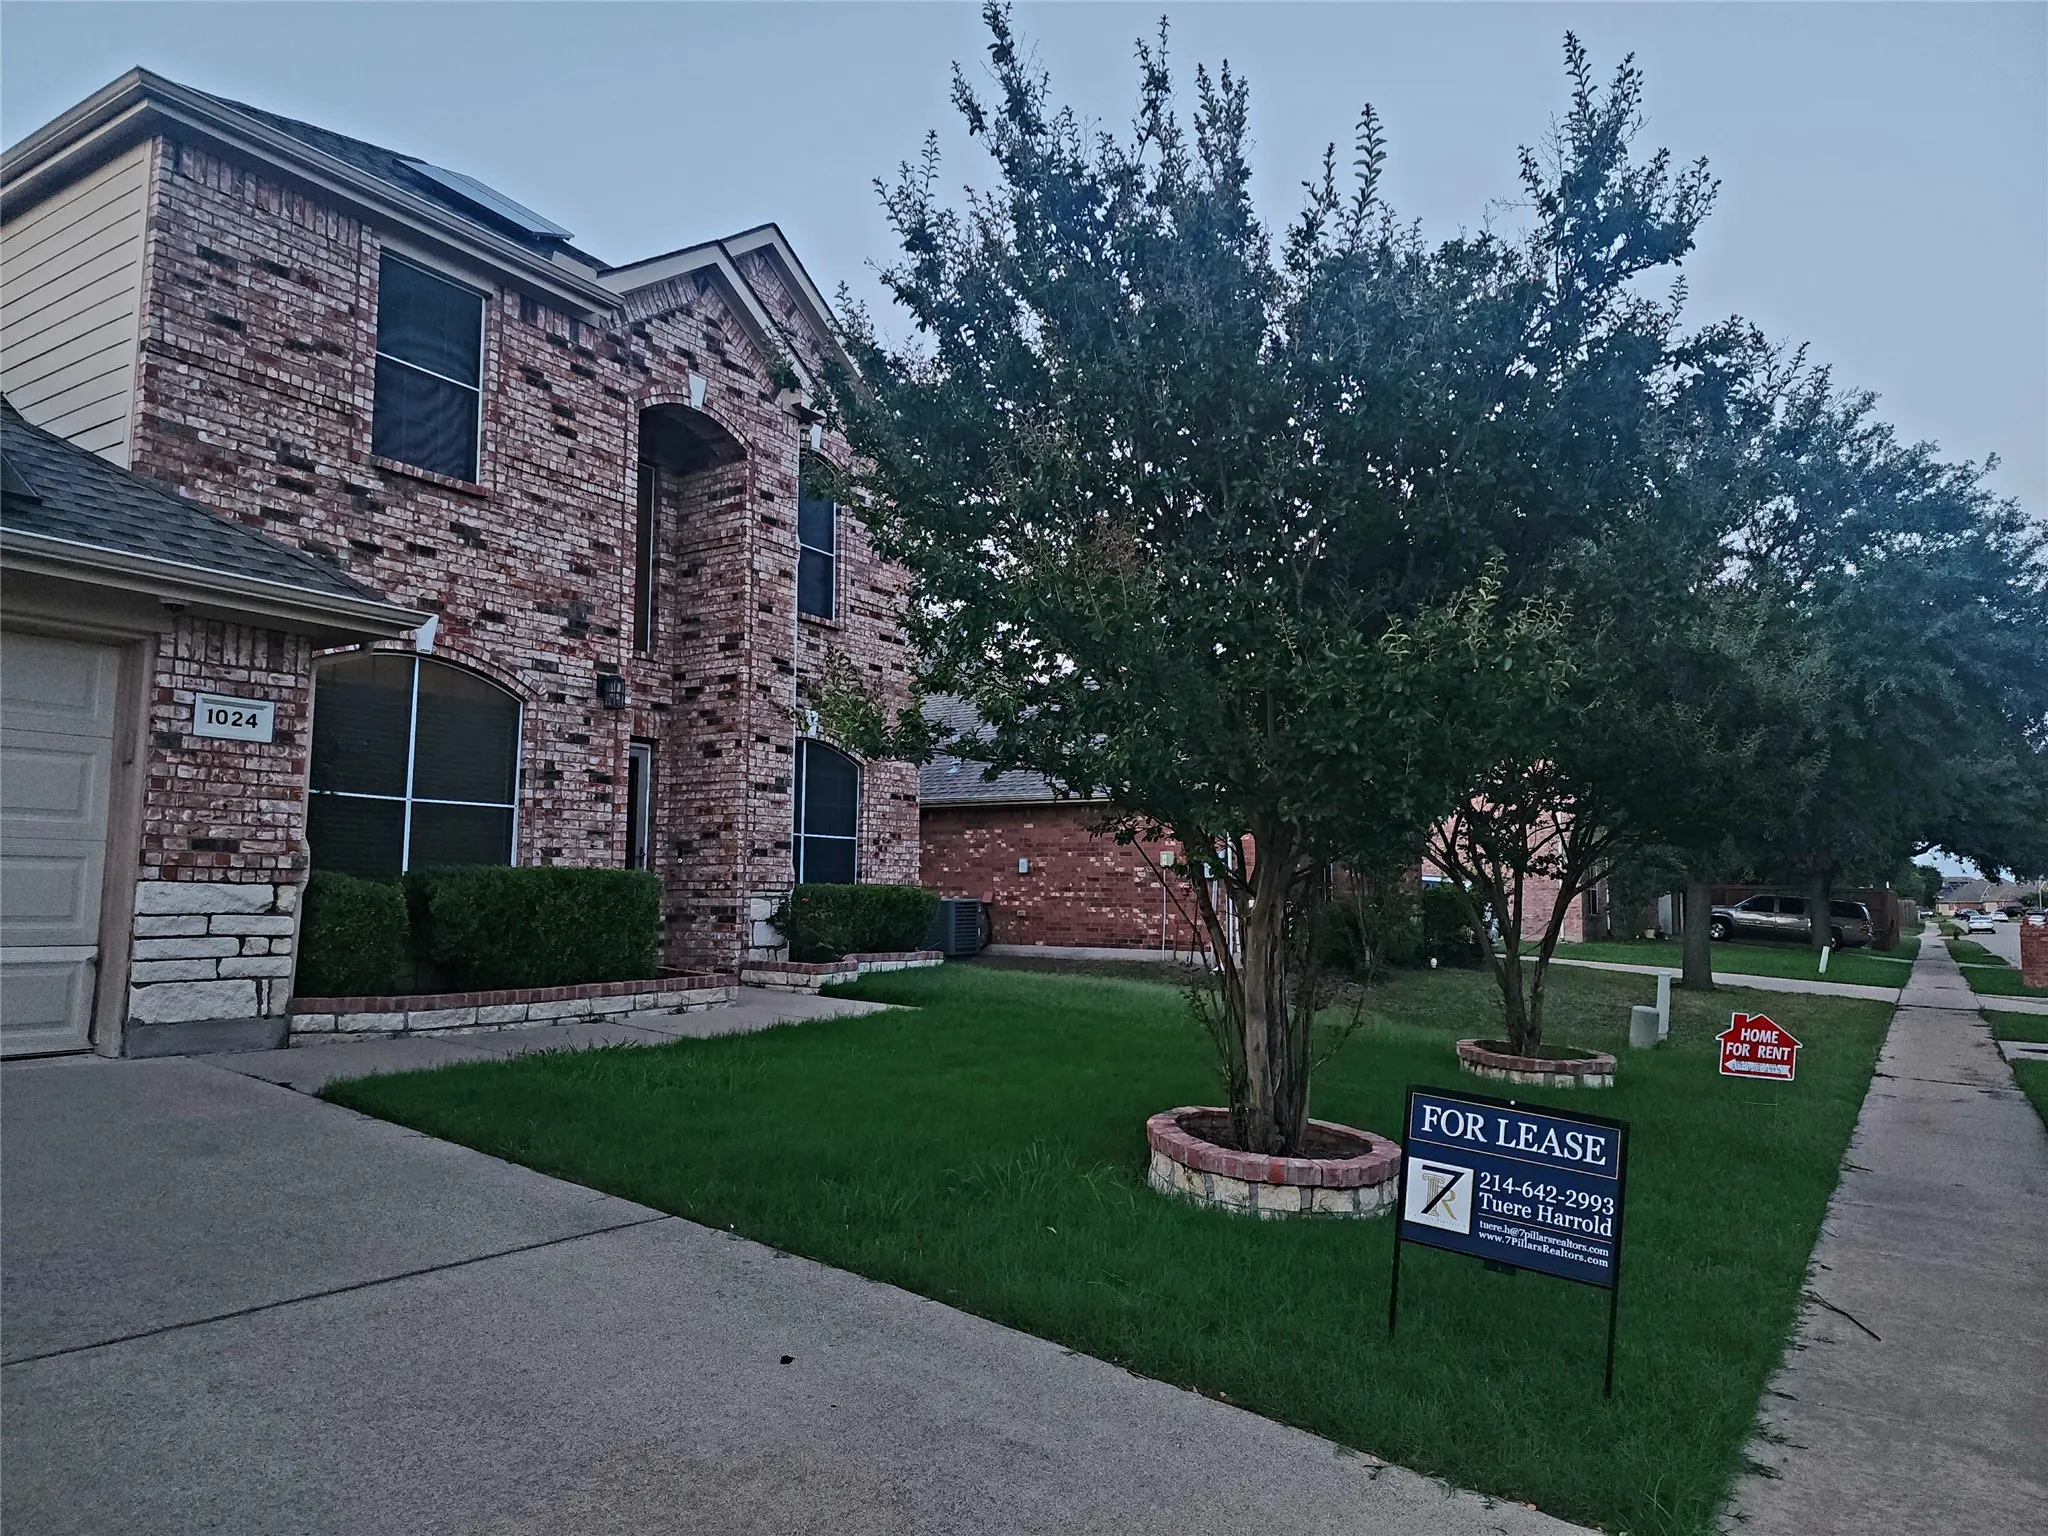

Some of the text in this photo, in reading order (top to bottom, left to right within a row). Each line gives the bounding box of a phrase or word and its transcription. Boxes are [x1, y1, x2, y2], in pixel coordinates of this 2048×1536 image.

[206, 708, 258, 728] 1024
[1726, 1042, 1791, 1060] FOR RENT
[1741, 1028, 1779, 1044] HOME
[1421, 1105, 1606, 1166] FOR LEASE
[1479, 1172, 1614, 1215] 214-642-2993
[1479, 1192, 1613, 1237] Tuere Harrold
[1479, 1220, 1609, 1257] tuere.h@7pillarsrealtors.com
[1479, 1231, 1609, 1267] www.7PillarsRealtors.com
